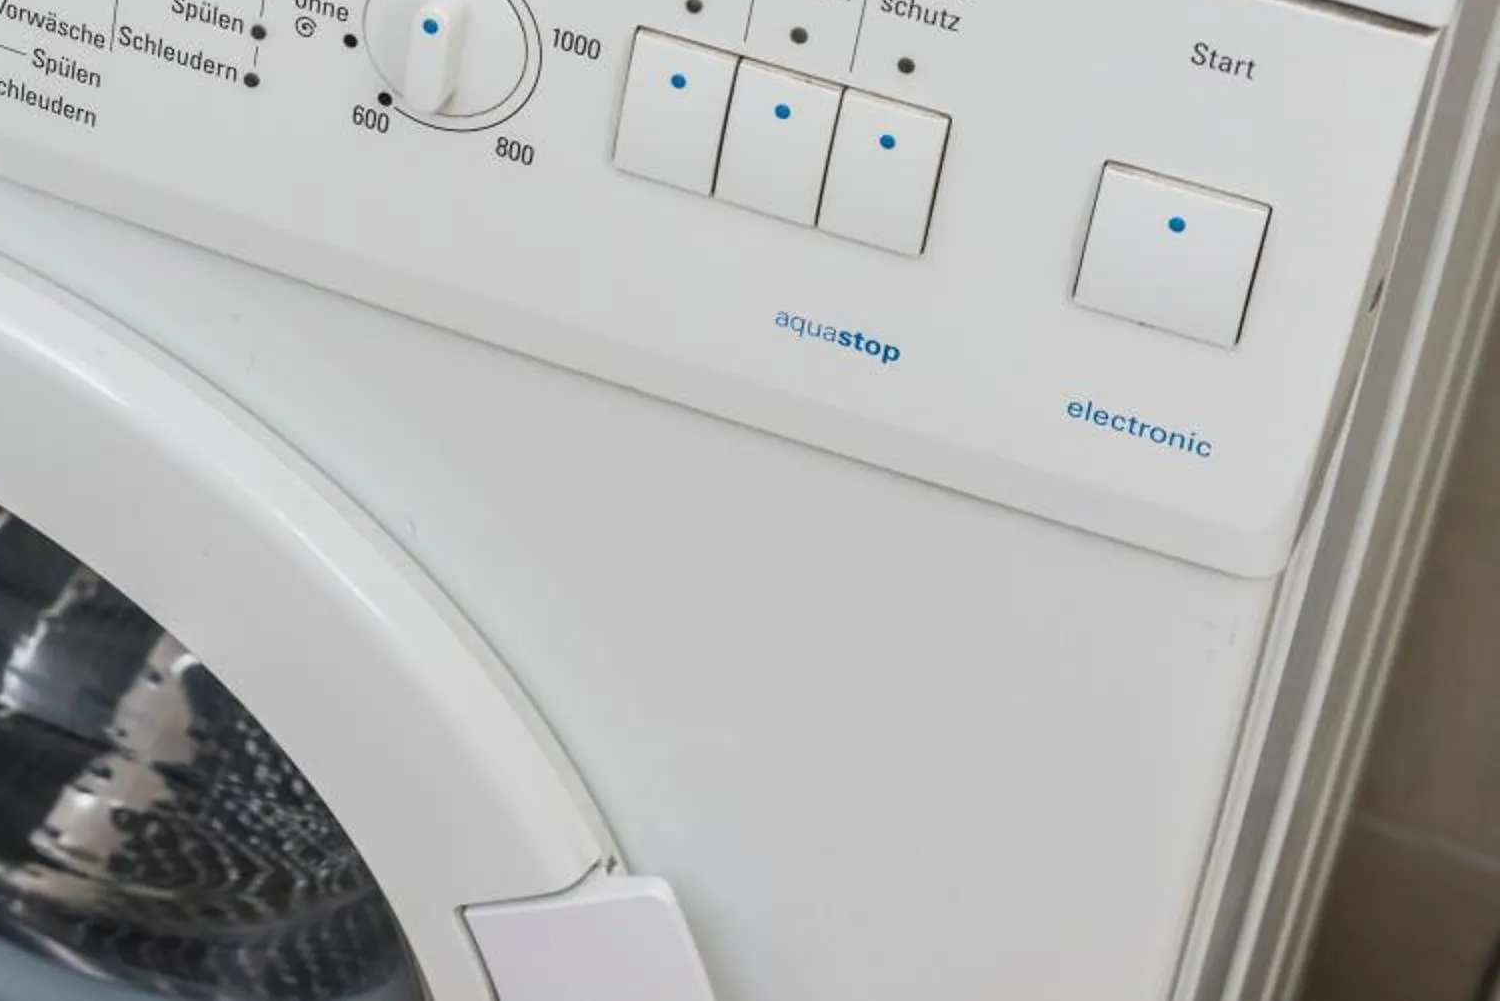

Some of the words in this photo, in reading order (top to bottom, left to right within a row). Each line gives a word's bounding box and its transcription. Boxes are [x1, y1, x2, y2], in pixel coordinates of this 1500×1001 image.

[118, 26, 237, 82] Schleudern
[552, 28, 601, 60] 1000
[1191, 42, 1256, 80] Start
[31, 48, 101, 88] Spülen
[352, 106, 390, 134] 600
[496, 138, 534, 166] 800
[775, 310, 900, 364] aquastop
[1067, 398, 1213, 457] electronic
